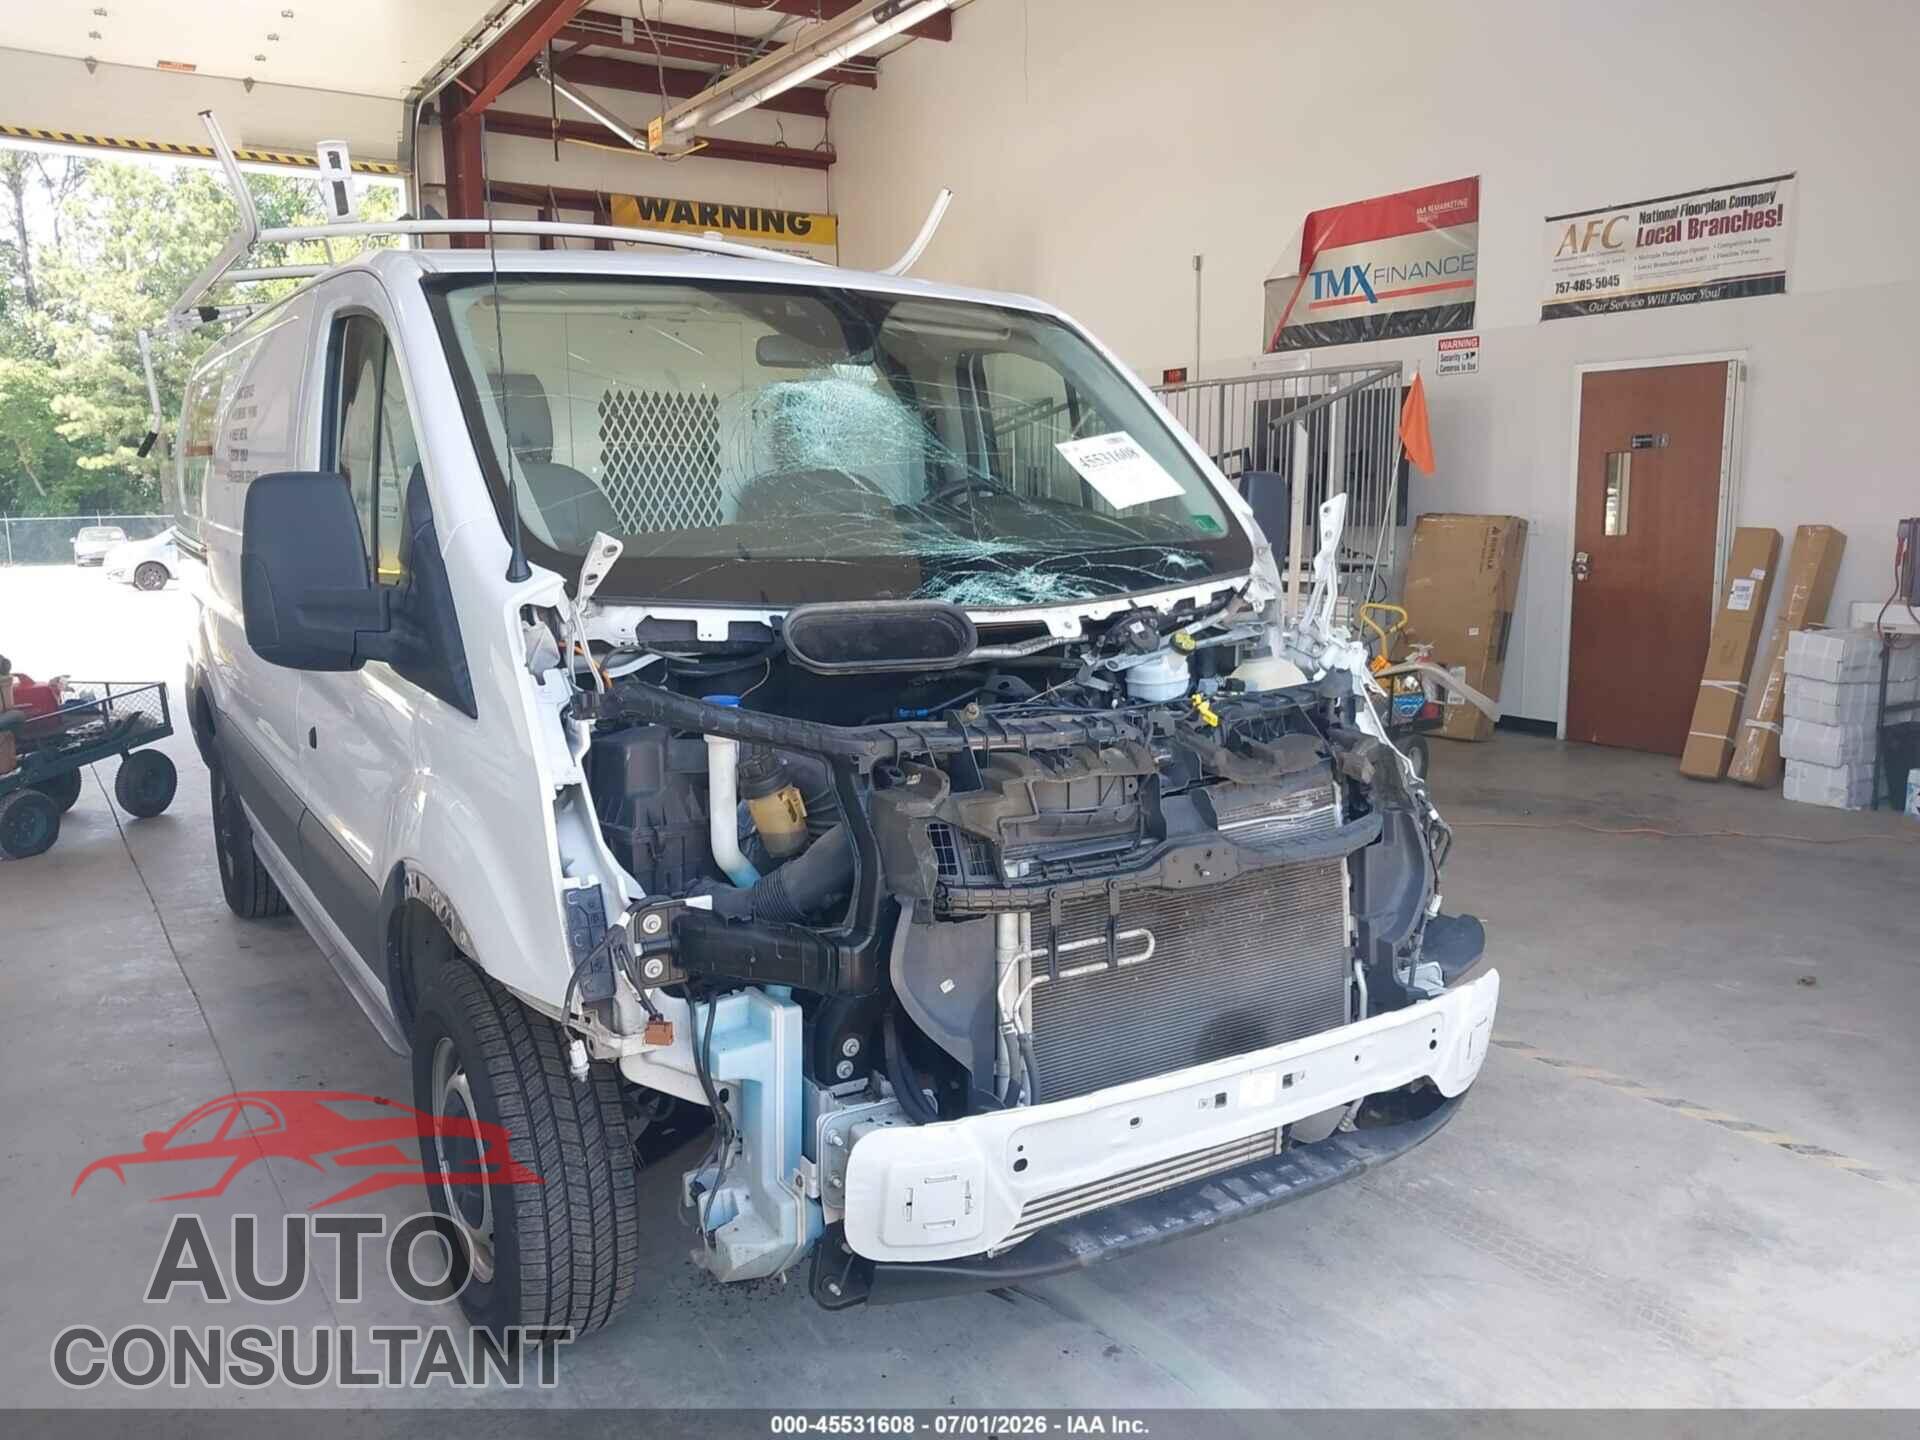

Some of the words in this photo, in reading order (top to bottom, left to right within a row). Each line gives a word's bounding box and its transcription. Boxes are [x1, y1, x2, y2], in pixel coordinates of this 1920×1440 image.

[634, 196, 812, 235] WARNING
[1636, 221, 1682, 248] Local
[1688, 204, 1784, 240] Branches!
[1639, 205, 1679, 225] National
[1680, 198, 1727, 218] Floorplan
[1729, 190, 1776, 209] Company
[1556, 214, 1630, 257] AFC
[1310, 263, 1378, 304] TMX
[1374, 253, 1475, 285] FINANCE
[1555, 274, 1620, 295] 757-485-5045
[1588, 301, 1609, 313] Our
[1610, 297, 1645, 311] Service
[1647, 293, 1669, 306] Will
[1670, 290, 1698, 304] Floor
[1439, 337, 1478, 350] WARNING
